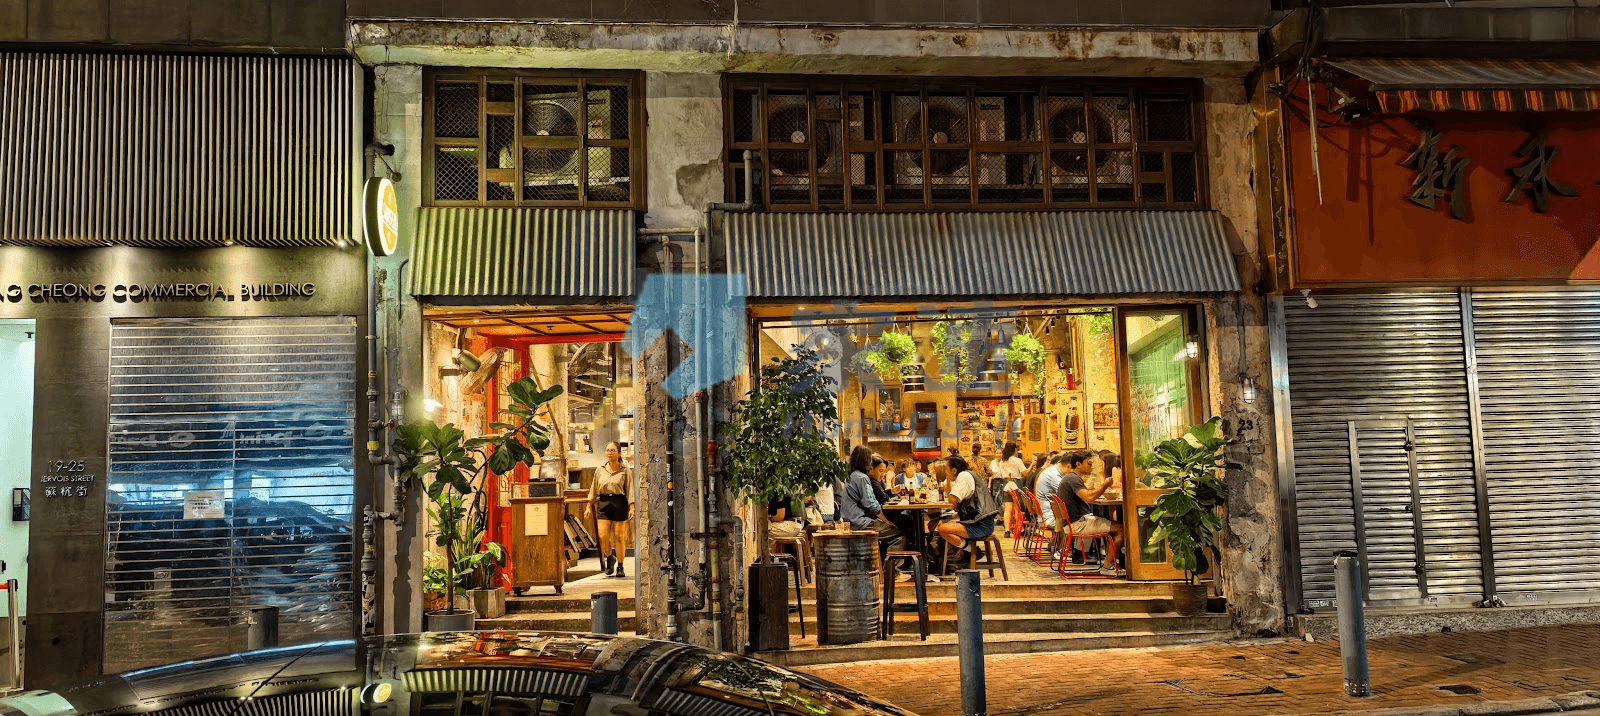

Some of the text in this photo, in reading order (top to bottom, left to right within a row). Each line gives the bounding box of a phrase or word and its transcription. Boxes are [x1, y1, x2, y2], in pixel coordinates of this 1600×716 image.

[28, 282, 106, 298] CHEONG
[113, 282, 235, 298] COMMERCIAL
[241, 281, 316, 297] BUILDING
[1237, 418, 1254, 431] 23
[48, 460, 85, 472] 19-25
